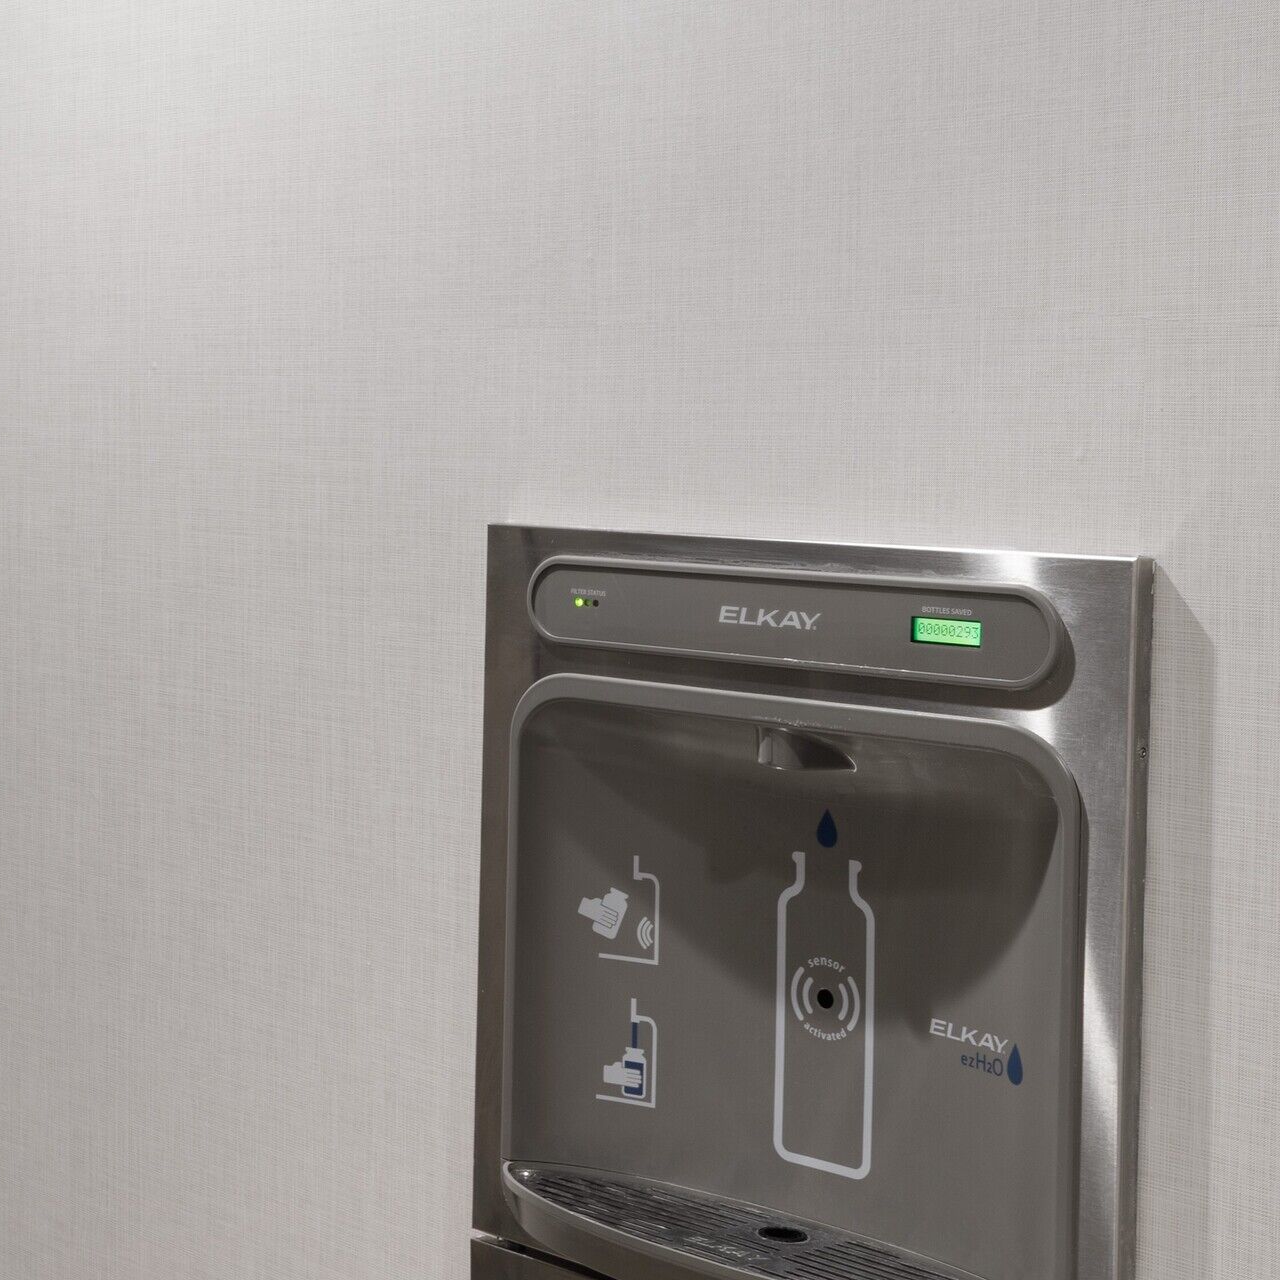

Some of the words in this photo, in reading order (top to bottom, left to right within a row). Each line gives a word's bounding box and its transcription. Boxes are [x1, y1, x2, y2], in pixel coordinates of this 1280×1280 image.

[718, 605, 822, 630] ELKAY
[921, 606, 950, 615] BOTTLES
[950, 608, 973, 616] SAVED
[918, 622, 980, 639] 00000293
[807, 956, 846, 973] sensor
[803, 1022, 847, 1041] activated
[928, 1017, 1009, 1054] ELKAY
